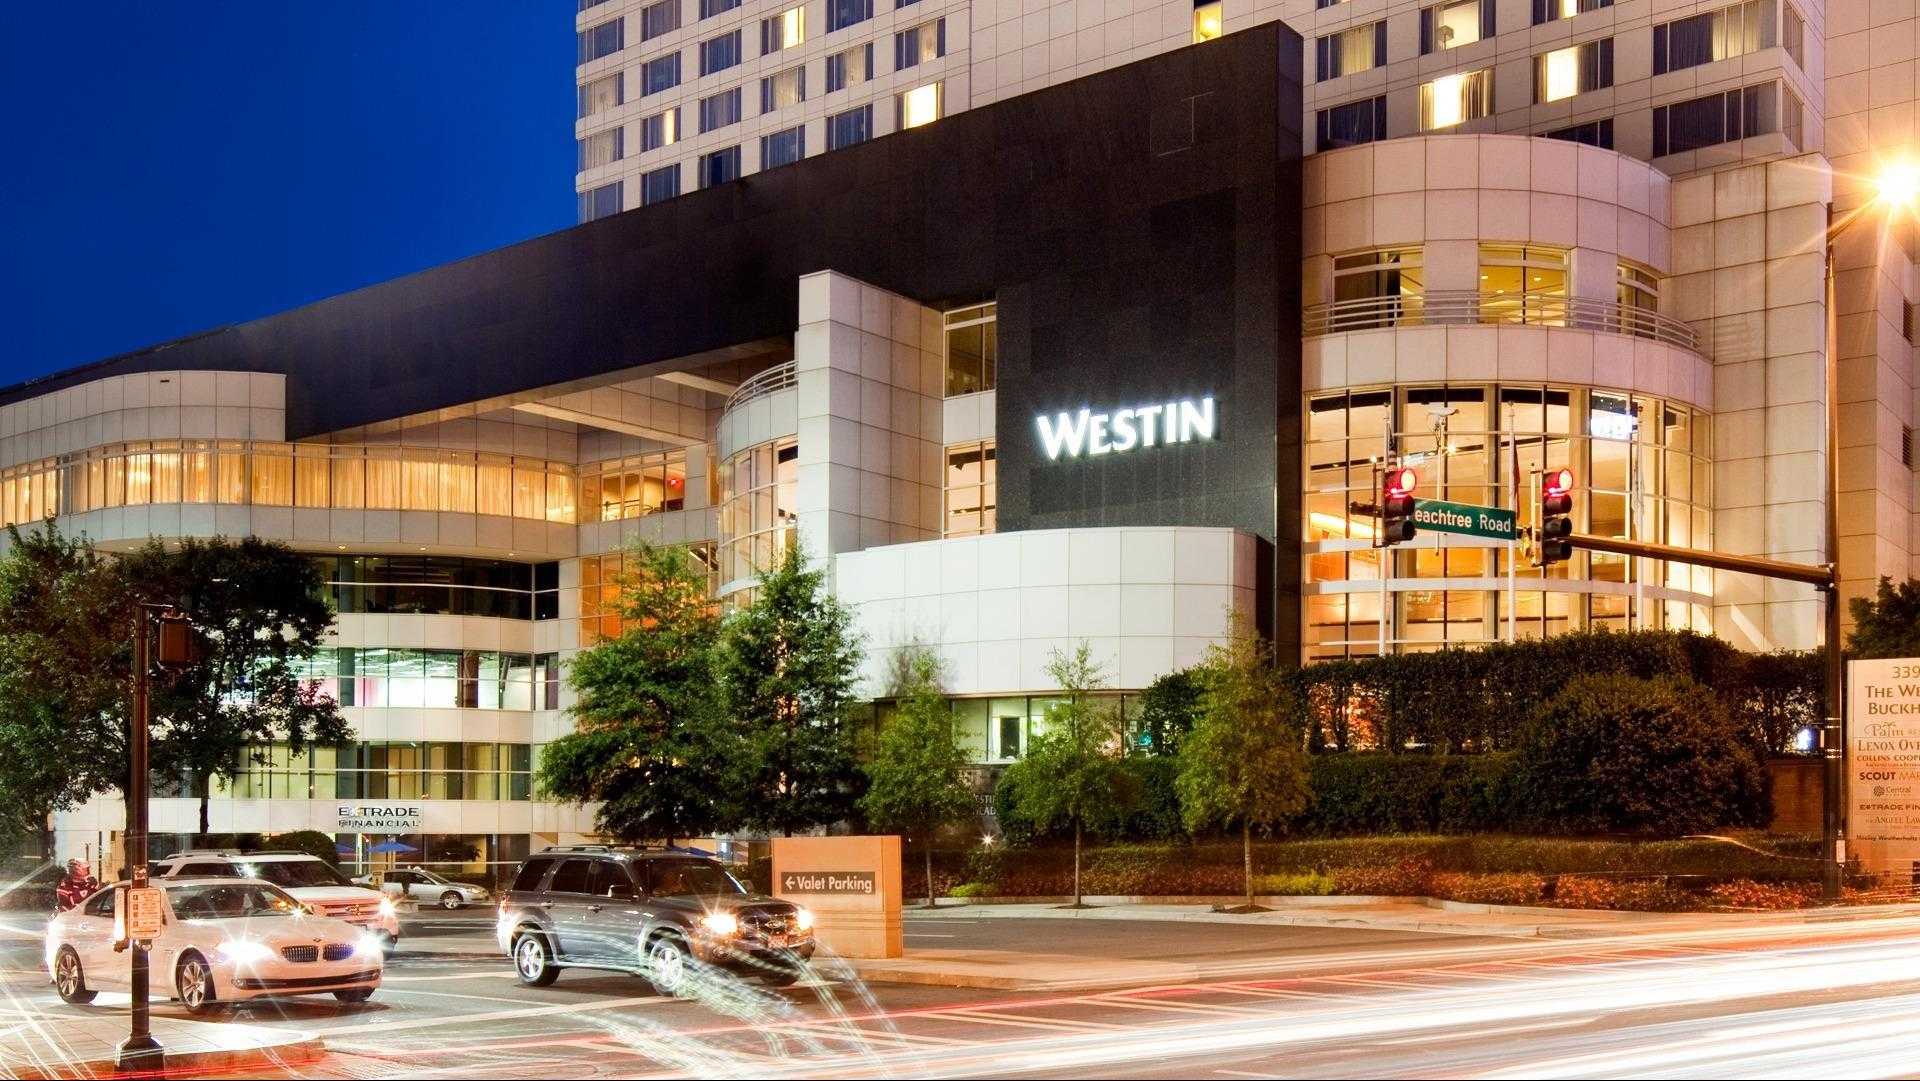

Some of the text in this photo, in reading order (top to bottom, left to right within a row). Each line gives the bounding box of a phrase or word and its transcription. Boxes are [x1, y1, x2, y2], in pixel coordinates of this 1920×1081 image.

[1036, 397, 1214, 461] WESTIN
[1414, 509, 1512, 533] eachtree Road
[1864, 685, 1894, 698] THE
[1868, 702, 1920, 715] BUCKH
[1859, 771, 1896, 780] SCOUT
[796, 875, 873, 894] Valet Parking
